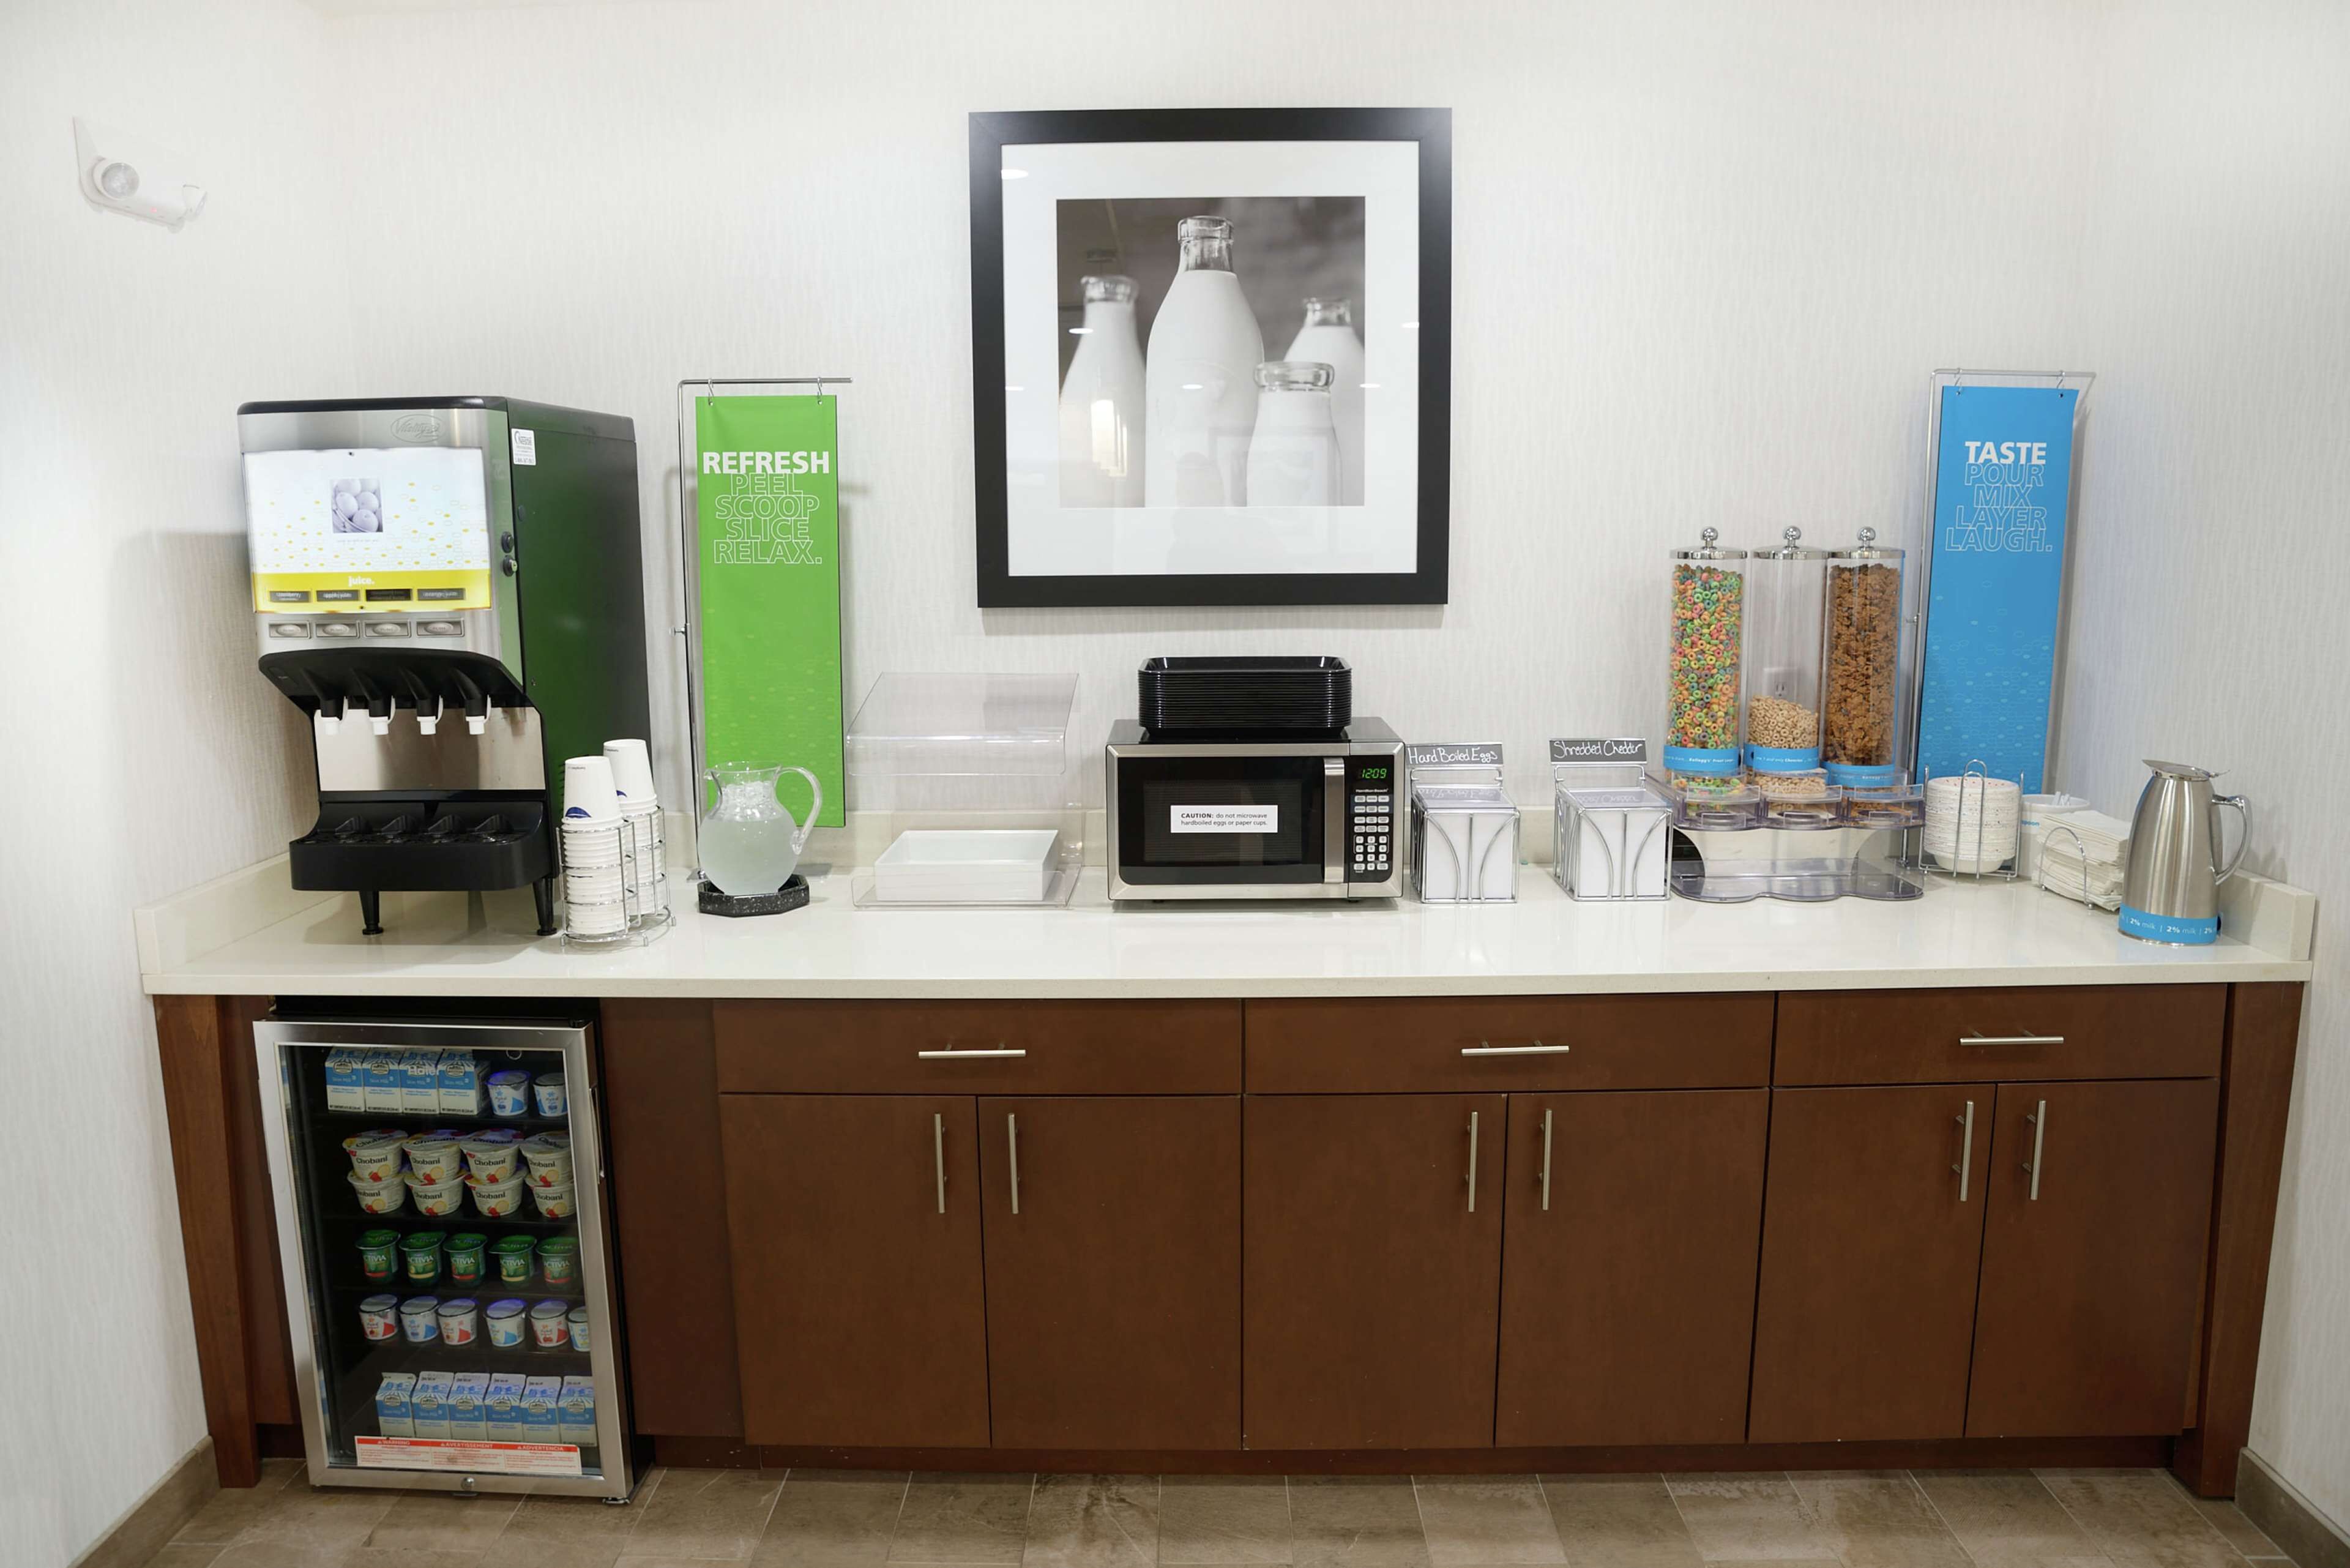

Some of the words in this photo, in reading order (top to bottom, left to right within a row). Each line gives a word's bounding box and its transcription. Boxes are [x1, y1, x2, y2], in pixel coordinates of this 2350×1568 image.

[703, 451, 829, 474] REFRESH
[1965, 441, 2046, 465] TASTE
[731, 472, 803, 496] PEEL
[1965, 462, 2044, 486] POUR
[715, 495, 819, 519] SCOOP
[1974, 484, 2032, 507] MIX
[1956, 506, 2046, 529] LAYER
[725, 518, 809, 542] SLICE
[1945, 528, 2053, 551] LAUGH.
[714, 540, 822, 564] RELAX.
[348, 575, 375, 588] juice.
[1408, 747, 1438, 764] Hard
[1438, 747, 1470, 763] Boiled
[1471, 747, 1498, 763] Eggs
[1554, 741, 1602, 758] Shredded
[356, 1155, 387, 1164] Chobani
[474, 1157, 505, 1166] Chobani
